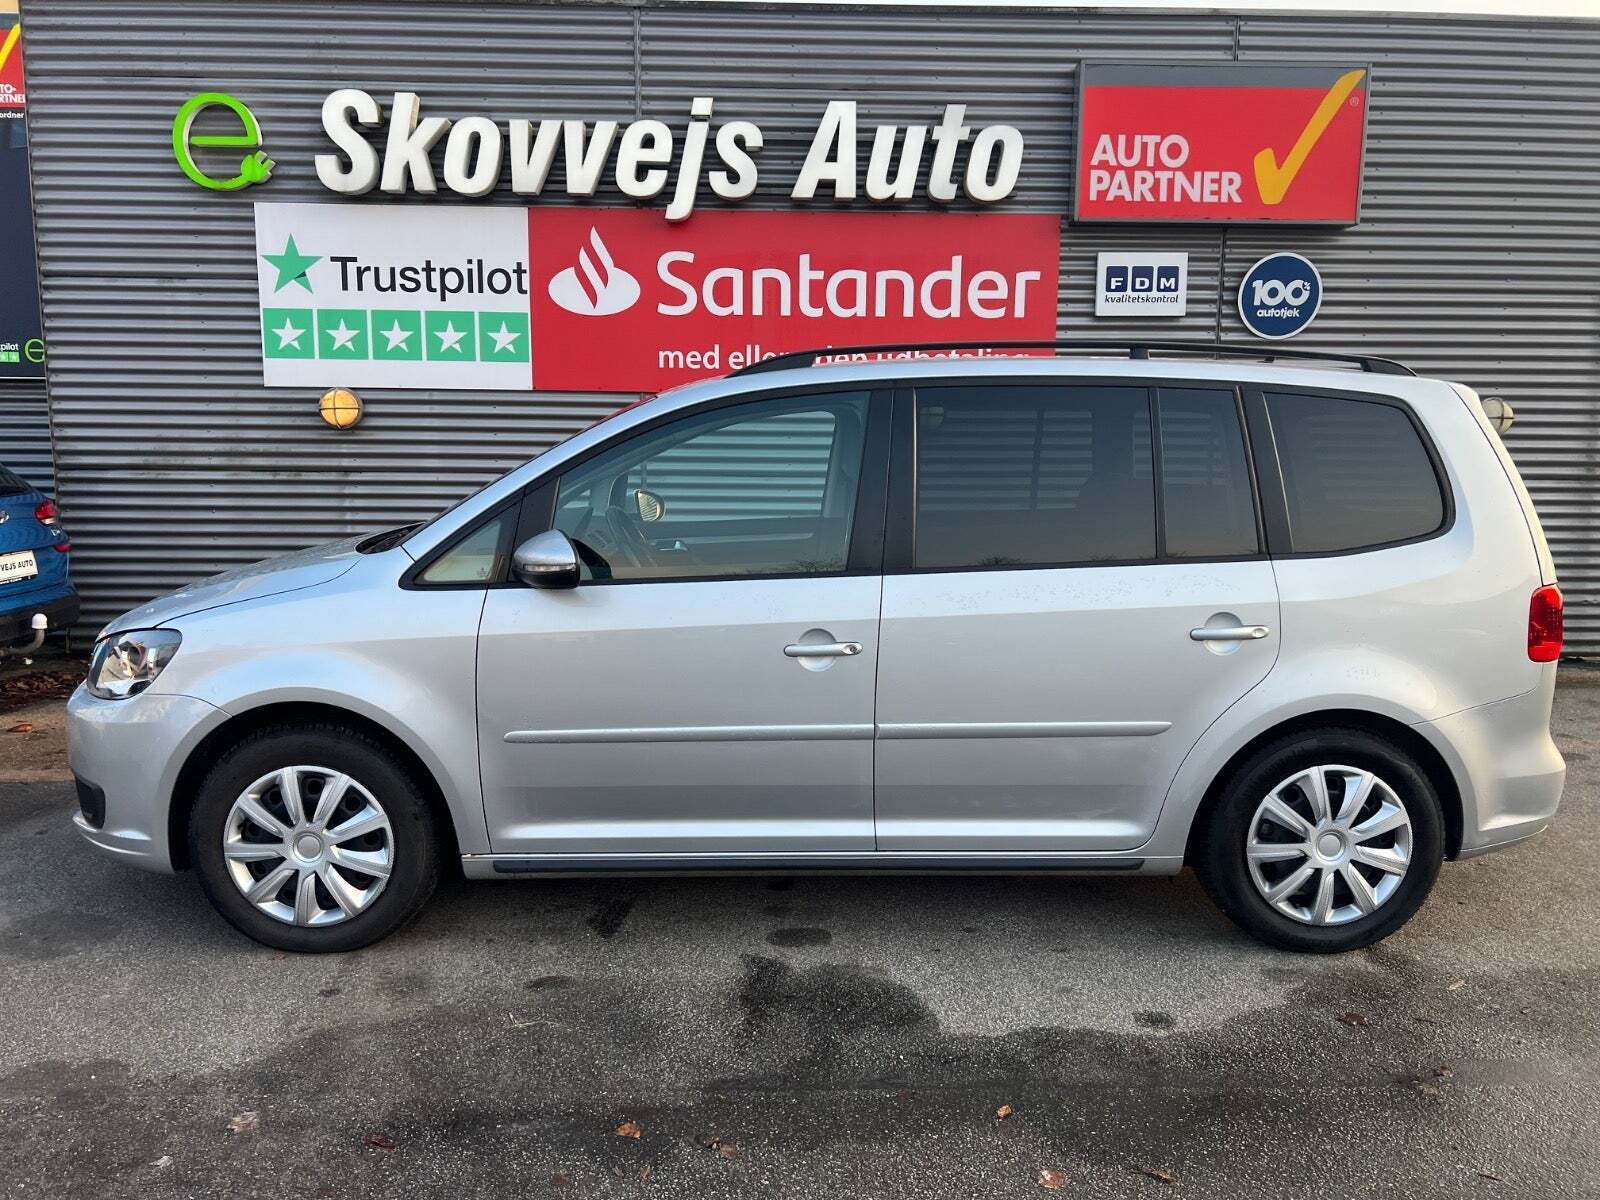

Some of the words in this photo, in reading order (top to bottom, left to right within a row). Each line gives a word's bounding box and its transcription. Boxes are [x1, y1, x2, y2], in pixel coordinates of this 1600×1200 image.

[314, 88, 764, 222] Skovvejs
[790, 100, 1025, 204] Auto
[1090, 134, 1190, 168] AUTO
[1089, 170, 1242, 203] PARTNER
[330, 256, 528, 301] Trustpilot
[657, 251, 1041, 319] Santander
[1105, 294, 1179, 304] kvalitetskontrol
[1256, 308, 1300, 318] autotjek
[658, 344, 720, 369] med
[18, 560, 33, 569] AUTO
